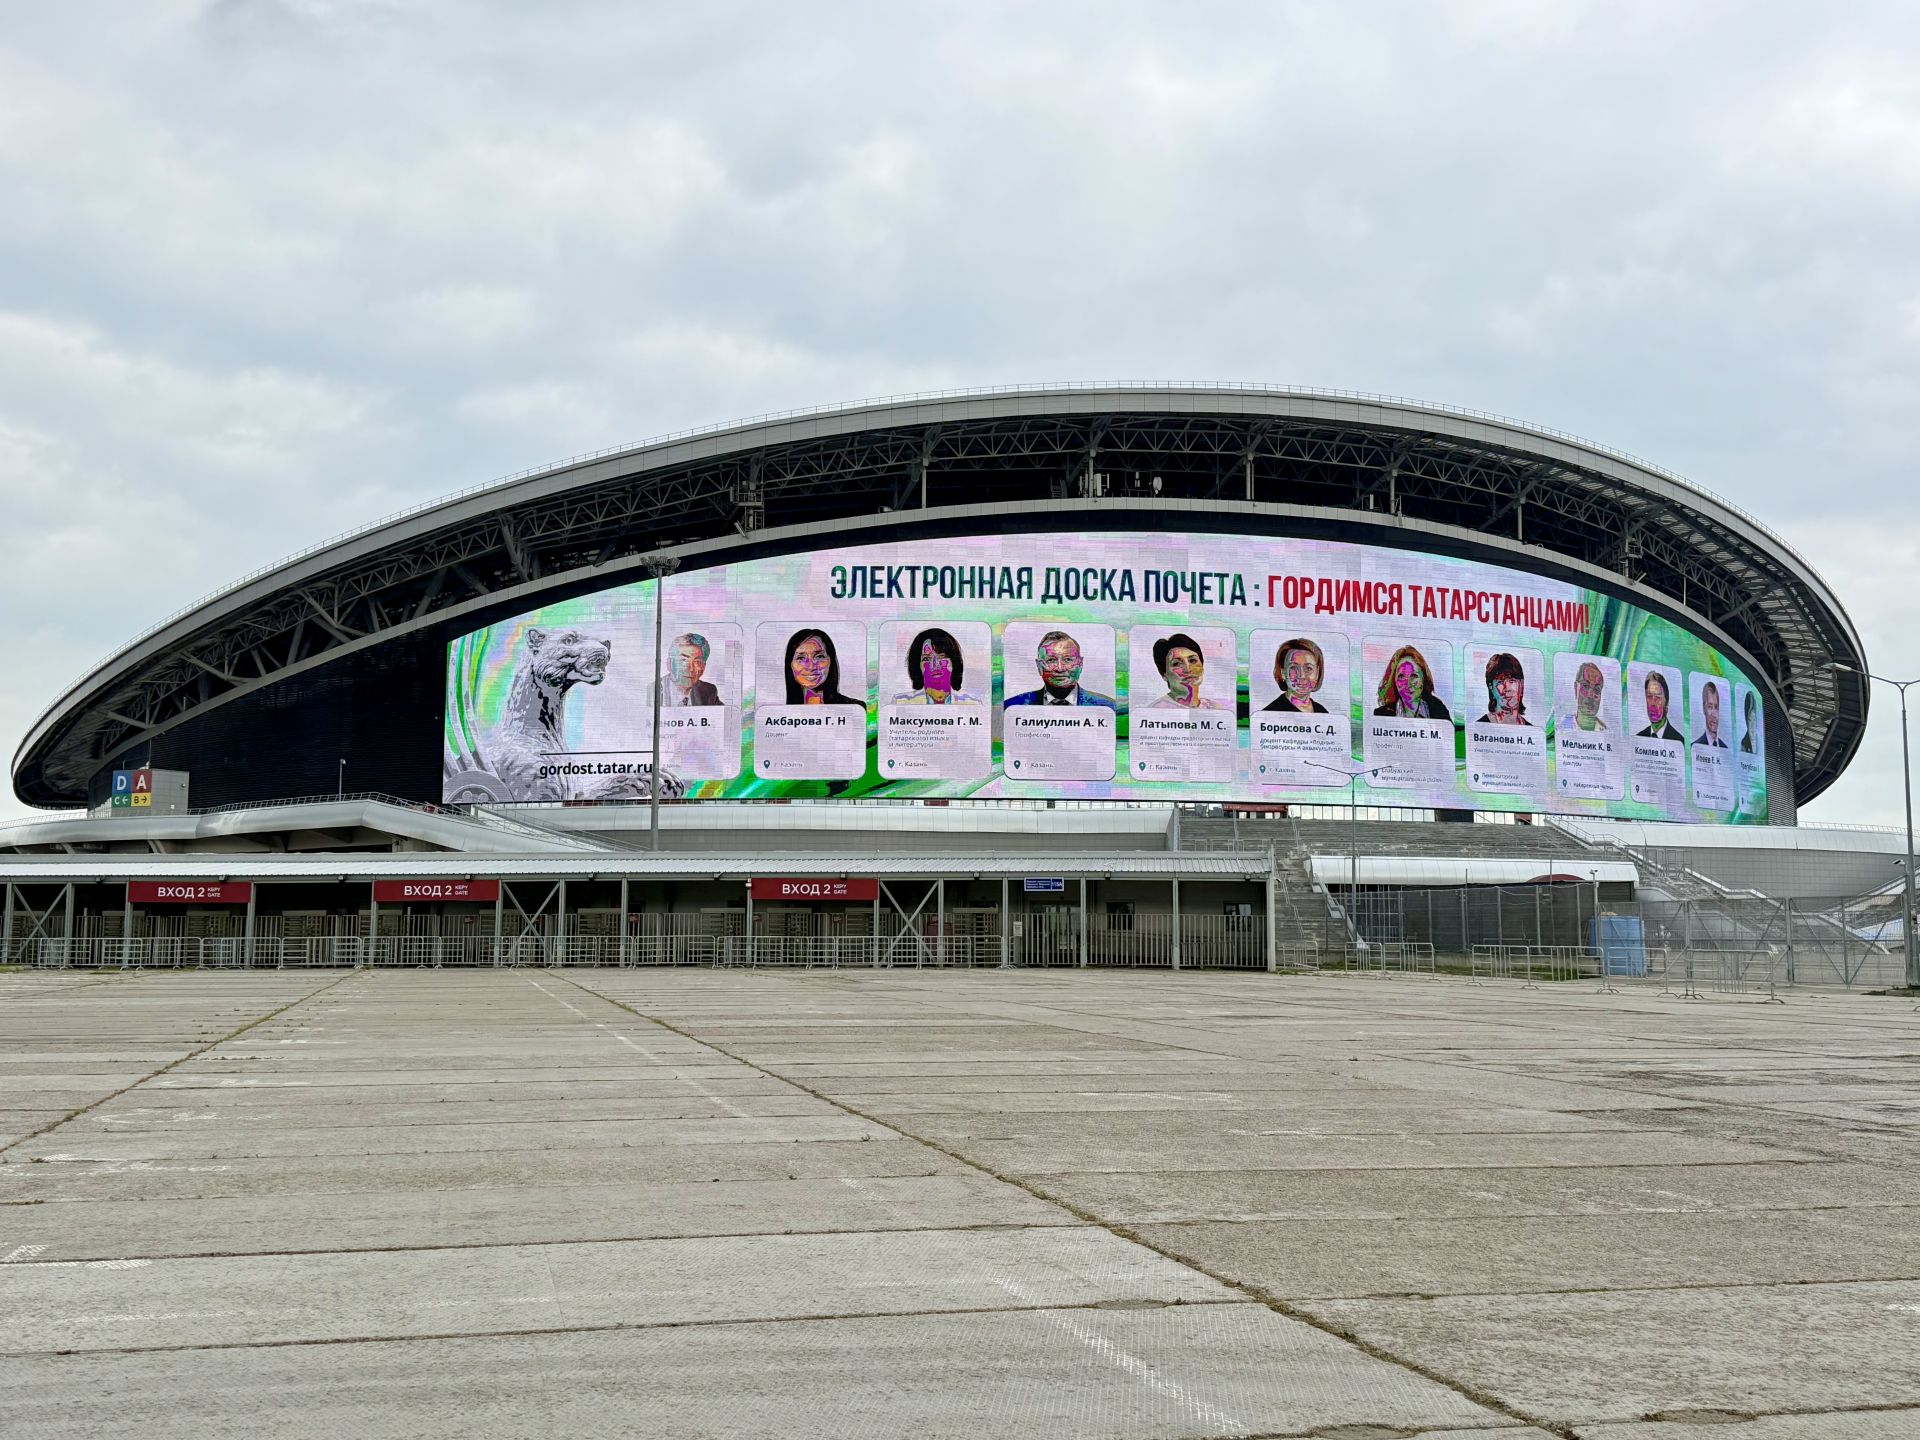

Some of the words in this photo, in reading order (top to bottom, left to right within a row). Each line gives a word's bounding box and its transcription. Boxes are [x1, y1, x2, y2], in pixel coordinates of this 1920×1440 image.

[830, 565, 1033, 599] ЭЛЕКТРОННАЯ
[1040, 566, 1136, 604] ДОСКА
[1143, 569, 1247, 606] ПОЧЕТА
[1268, 575, 1403, 615] ГОРДИМСЯ
[1408, 584, 1590, 634] ТАТАРСТАНЦАМИ!
[687, 717, 698, 727] А.
[700, 717, 711, 727] В.
[765, 716, 822, 728] Акбарова
[825, 716, 835, 726] Г.
[837, 716, 846, 726] Н
[889, 716, 954, 729] Максумова
[957, 716, 967, 726] Г.
[969, 716, 983, 726] М.
[1015, 717, 1081, 729] Галиуллин
[1083, 718, 1095, 728] А.
[1097, 718, 1109, 728] К.
[1140, 719, 1198, 731] Латыпова
[1200, 720, 1214, 730] М.
[1216, 720, 1227, 730] С.
[1260, 722, 1312, 735] Борисова
[1314, 724, 1324, 734] С.
[1326, 725, 1337, 736] Д.
[1372, 727, 1418, 738] Шастина
[1420, 729, 1429, 739] Е.
[1430, 730, 1442, 740] М.
[1473, 733, 1515, 744] Ваганова
[1516, 736, 1526, 745] Н.
[1527, 736, 1536, 746] А.
[1562, 739, 1597, 751] Мельник
[1598, 743, 1606, 751] К.
[1606, 744, 1613, 752] В.
[1634, 746, 1659, 757] Комлев
[1660, 750, 1668, 758] Ю.
[1669, 751, 1677, 759] Ю.
[539, 762, 653, 779] gordost.tatar.ru
[116, 775, 127, 790] D
[136, 774, 147, 790] A
[114, 796, 120, 805] C
[133, 795, 139, 804] B
[157, 887, 194, 899] ВХОД
[197, 887, 205, 897] 2
[404, 885, 442, 897] ВХОД
[444, 885, 452, 895] 2
[782, 883, 820, 896] ВХОД
[823, 883, 831, 894] 2
